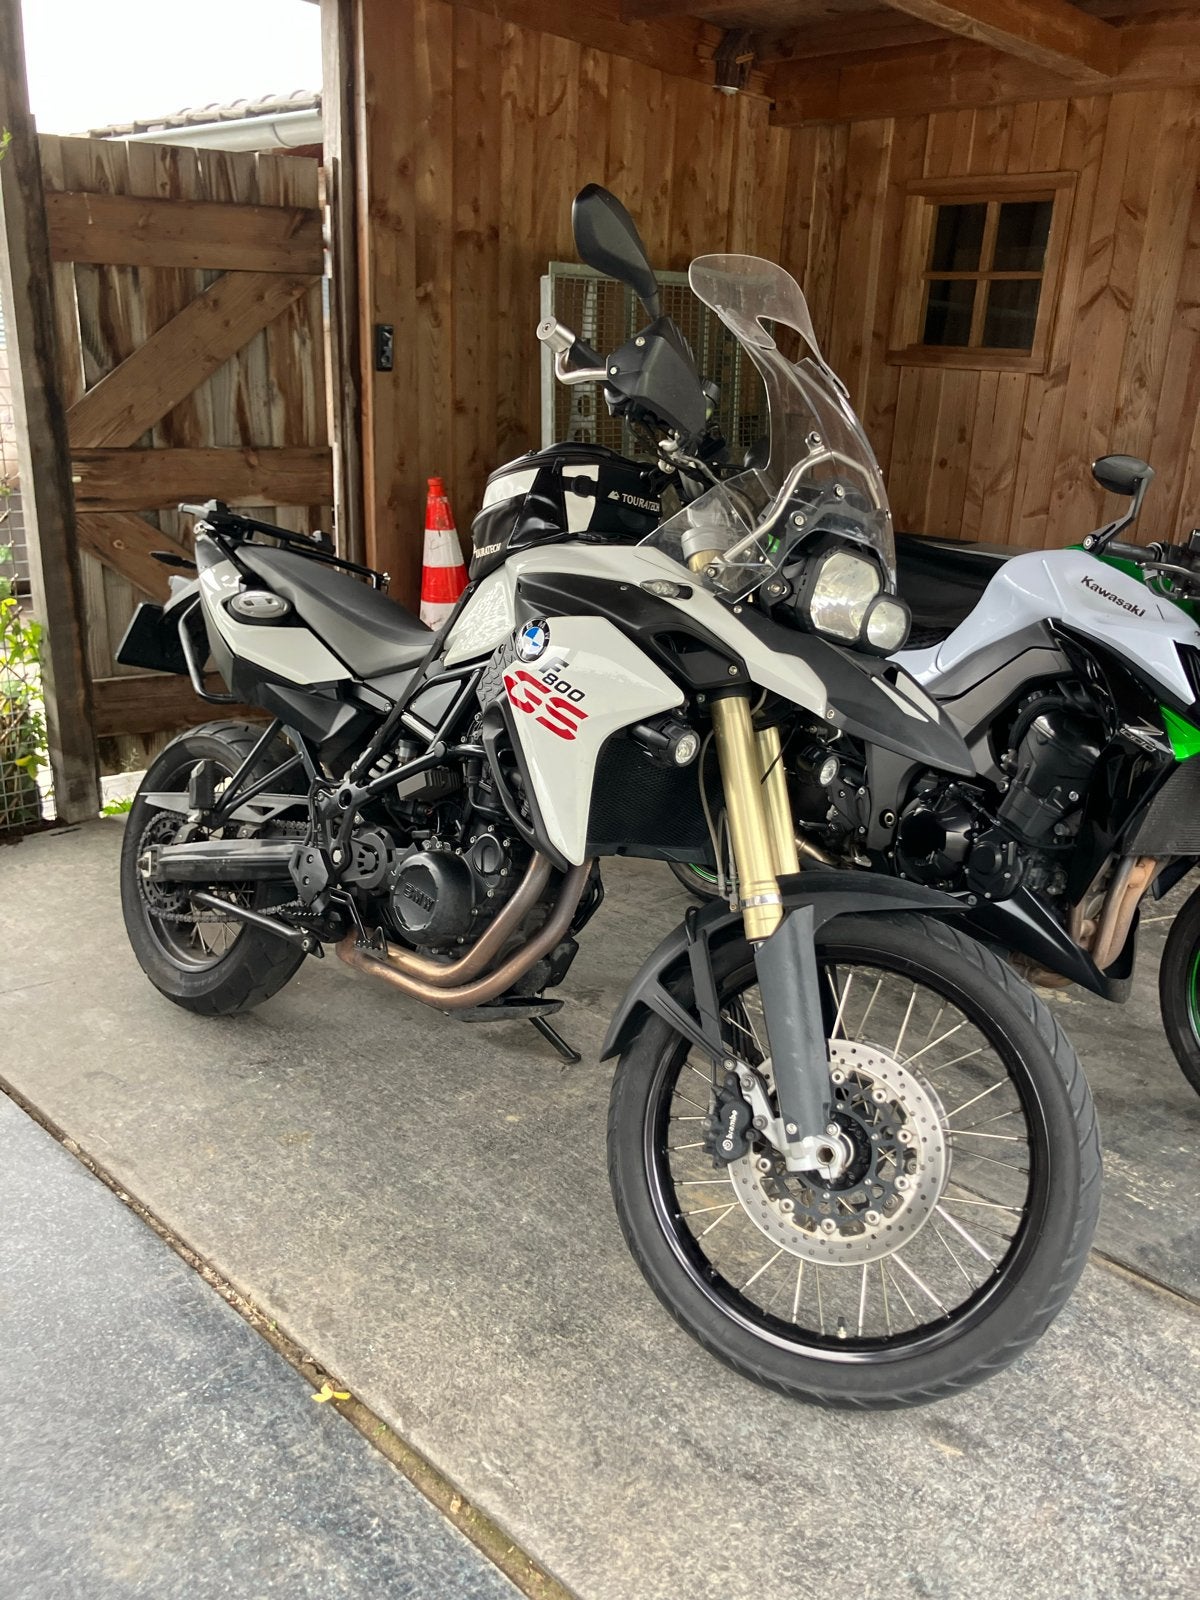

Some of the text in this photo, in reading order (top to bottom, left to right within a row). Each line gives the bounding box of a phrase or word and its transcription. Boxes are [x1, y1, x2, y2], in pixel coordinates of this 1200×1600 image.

[621, 493, 660, 512] TOURATECH
[1081, 575, 1146, 617] Kawasaki
[538, 656, 570, 674] F
[541, 672, 586, 703] 800
[503, 670, 589, 741] GS
[725, 1109, 738, 1140] brembo
